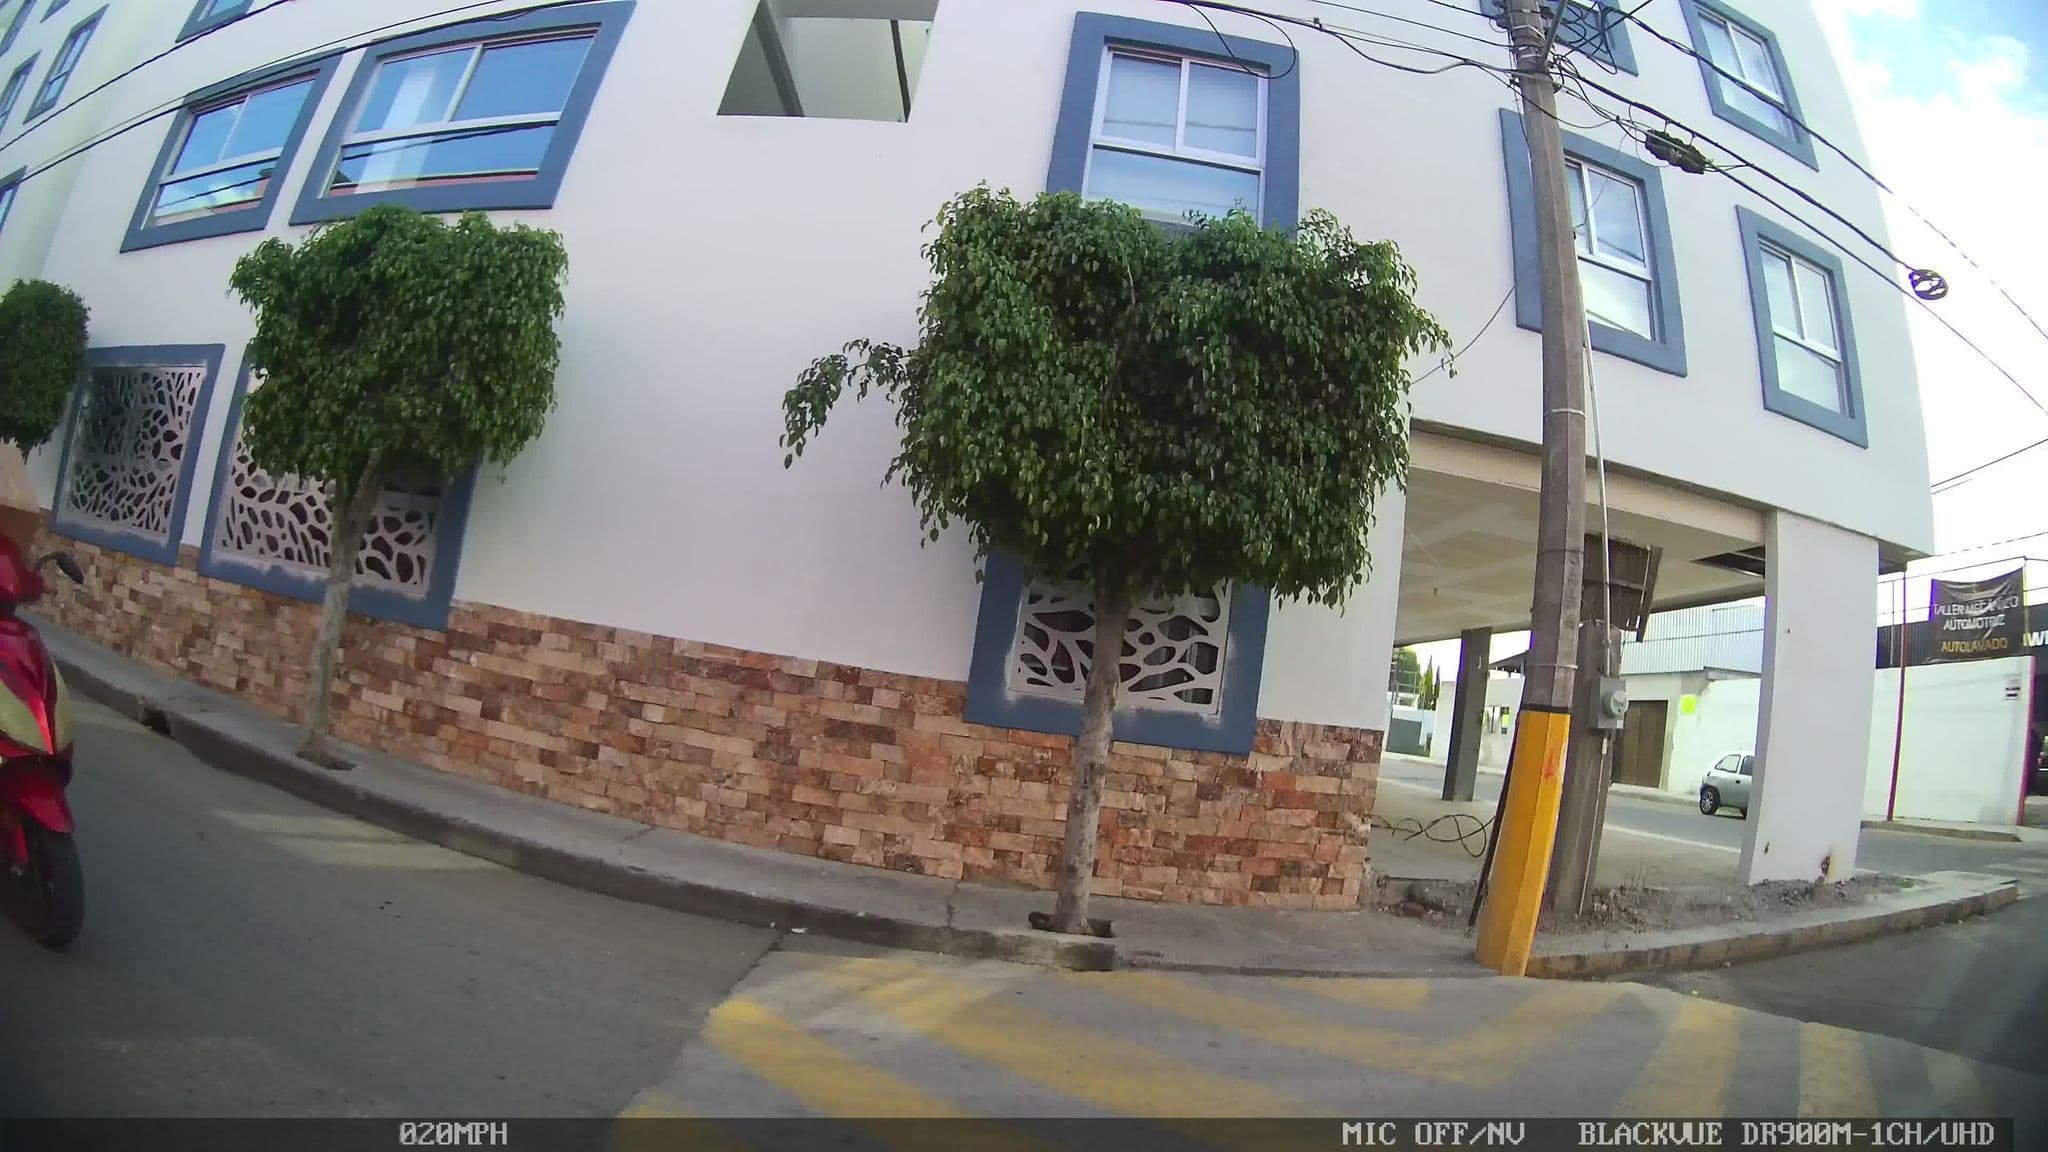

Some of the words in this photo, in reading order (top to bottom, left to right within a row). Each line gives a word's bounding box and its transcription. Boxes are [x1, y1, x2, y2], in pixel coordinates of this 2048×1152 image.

[1933, 602, 1965, 616] TALLER
[1943, 613, 2006, 631] AUTOMOTRIZ
[1941, 637, 2008, 653] AUTOLAVADO
